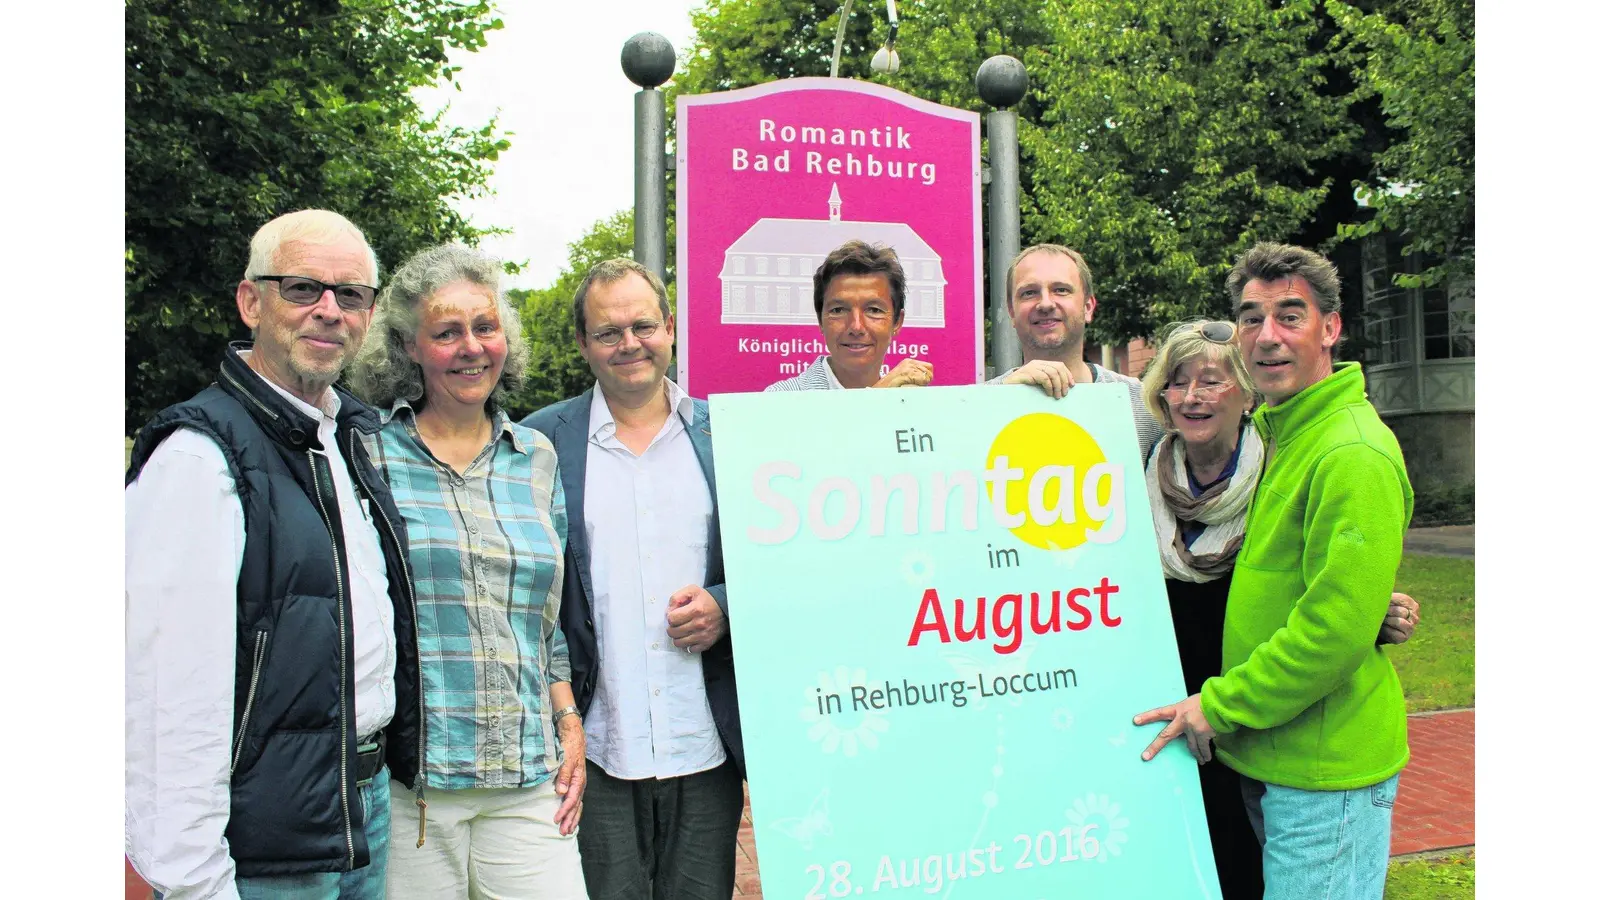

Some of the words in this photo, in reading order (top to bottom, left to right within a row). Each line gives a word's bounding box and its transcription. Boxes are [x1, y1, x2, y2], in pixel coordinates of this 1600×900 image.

[759, 119, 911, 149] Romantik
[732, 148, 790, 173] Bad
[806, 151, 936, 185] Rehburg
[895, 427, 934, 454] Ein
[746, 455, 1127, 546] Sonntag
[987, 544, 1020, 569] im
[907, 577, 1122, 654] August
[816, 687, 842, 715] in
[851, 665, 1078, 713] Rehburg-Loccum
[804, 860, 864, 900] 28.
[872, 840, 1005, 894] August
[1013, 823, 1101, 869] 2016
